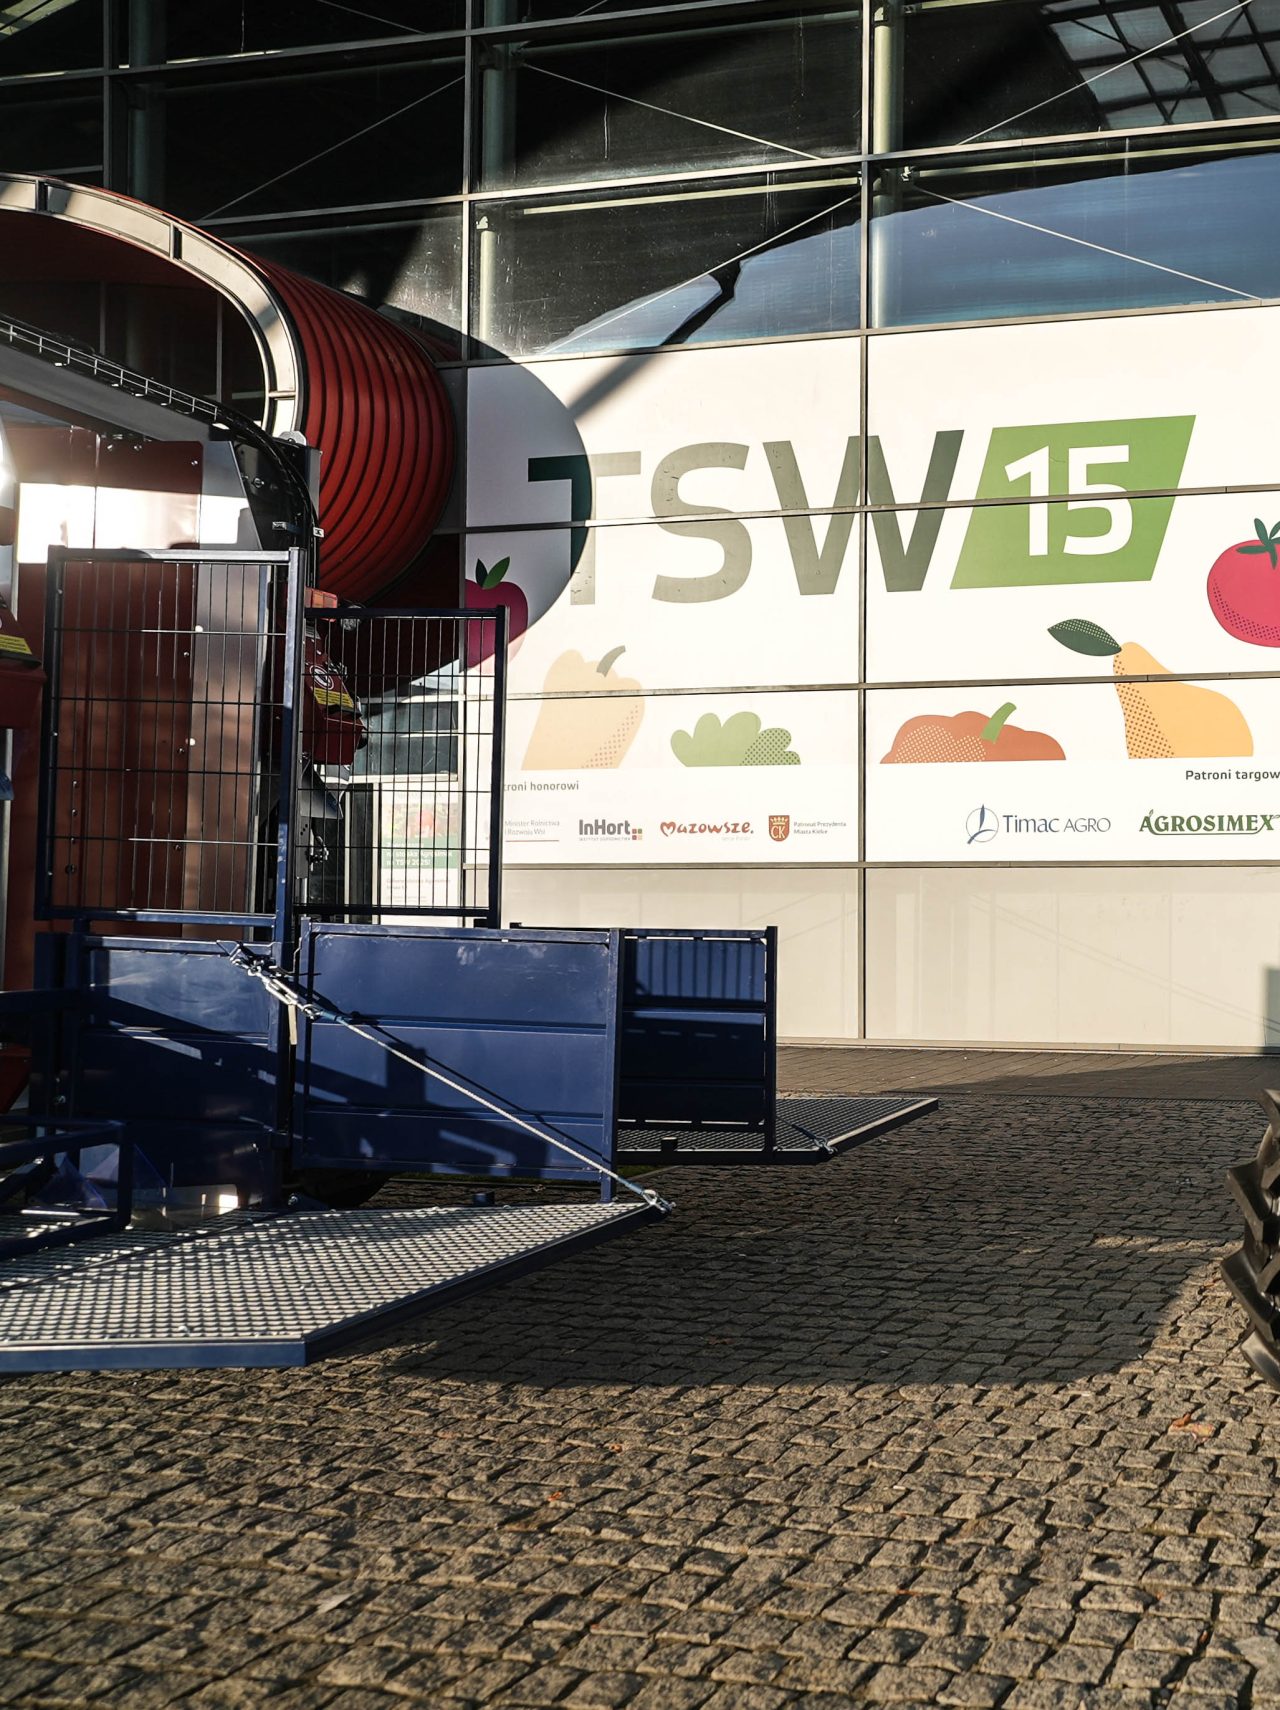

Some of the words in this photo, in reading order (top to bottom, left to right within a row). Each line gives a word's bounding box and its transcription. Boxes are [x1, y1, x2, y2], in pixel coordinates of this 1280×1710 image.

[528, 430, 964, 604] TSW
[1005, 444, 1133, 556] 15
[1185, 769, 1231, 781] Patroni
[530, 780, 579, 792] honorowi
[579, 818, 630, 836] InHort
[1003, 814, 1059, 833] Timac
[1064, 817, 1111, 833] AGRO
[1138, 810, 1280, 835] AGROSIMEX
[770, 825, 786, 840] CK
